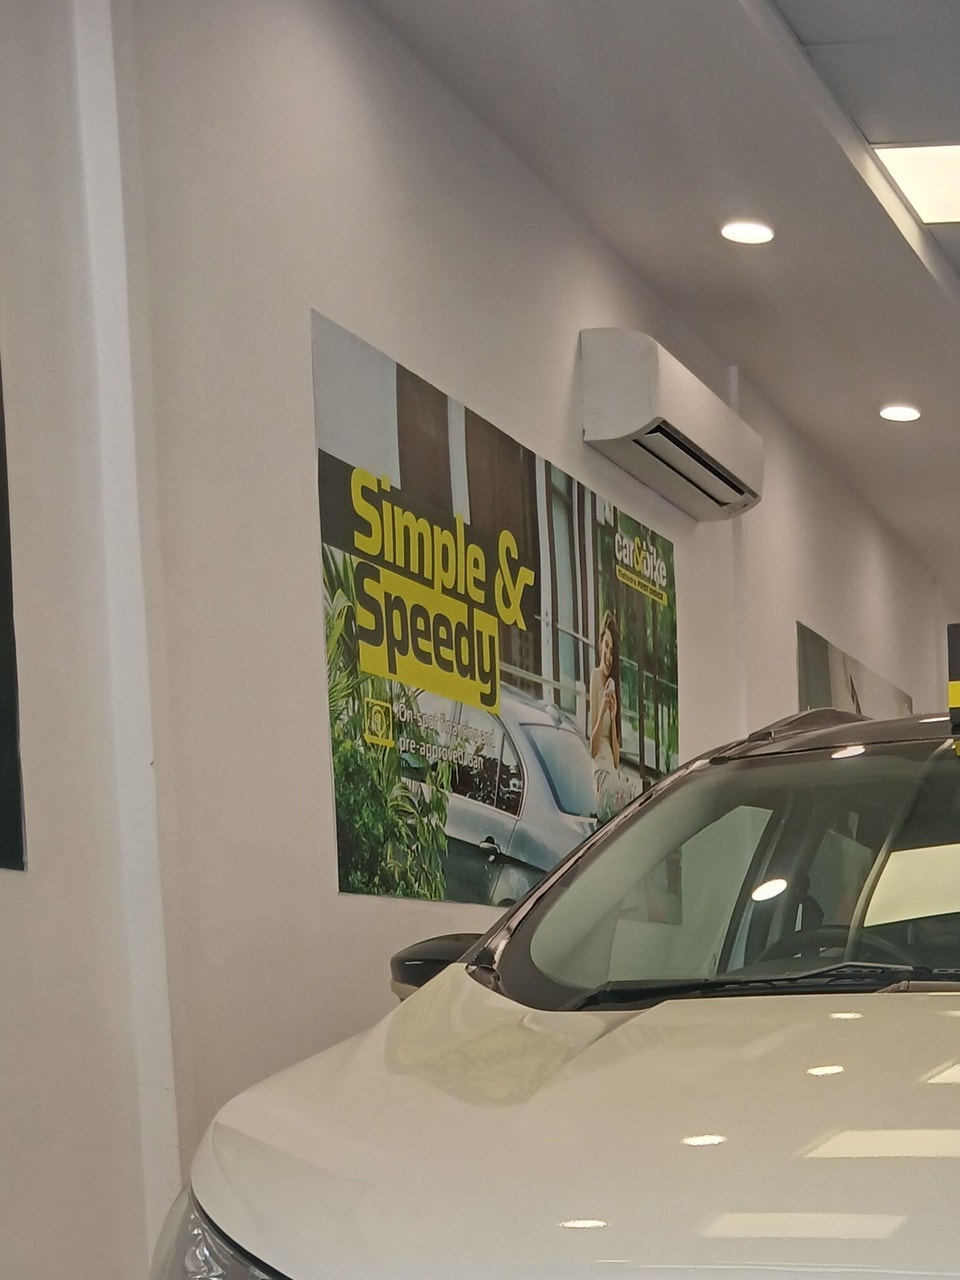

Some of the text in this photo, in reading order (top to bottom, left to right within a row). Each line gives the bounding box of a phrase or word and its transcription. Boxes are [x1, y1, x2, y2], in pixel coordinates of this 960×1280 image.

[351, 467, 535, 631] Simple &
[615, 532, 667, 590] car&bike
[355, 561, 496, 707] Speedy
[400, 736, 464, 765] pre-approved
